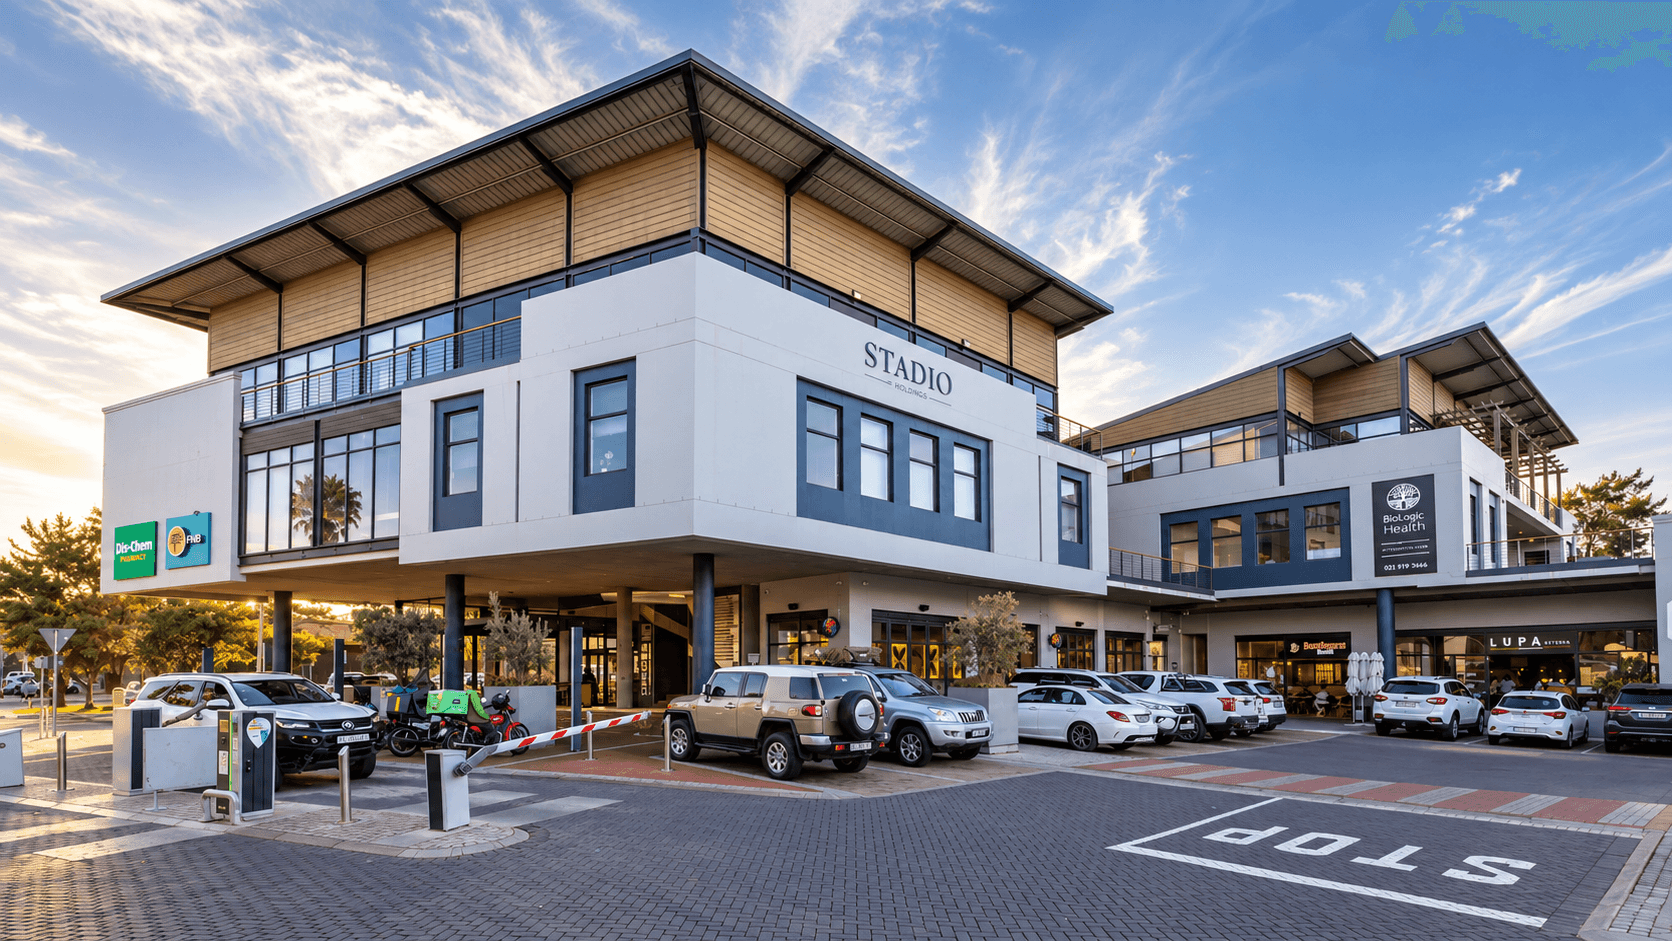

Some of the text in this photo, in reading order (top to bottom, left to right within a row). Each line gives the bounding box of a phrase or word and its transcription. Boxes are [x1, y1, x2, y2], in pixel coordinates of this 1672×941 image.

[864, 341, 953, 396] STADIO
[894, 381, 928, 400] HOLDINGS
[1383, 511, 1425, 524] BioLogic
[1384, 520, 1426, 535] Health
[1489, 636, 1542, 647] LUPA
[1202, 826, 1537, 885] STOP
